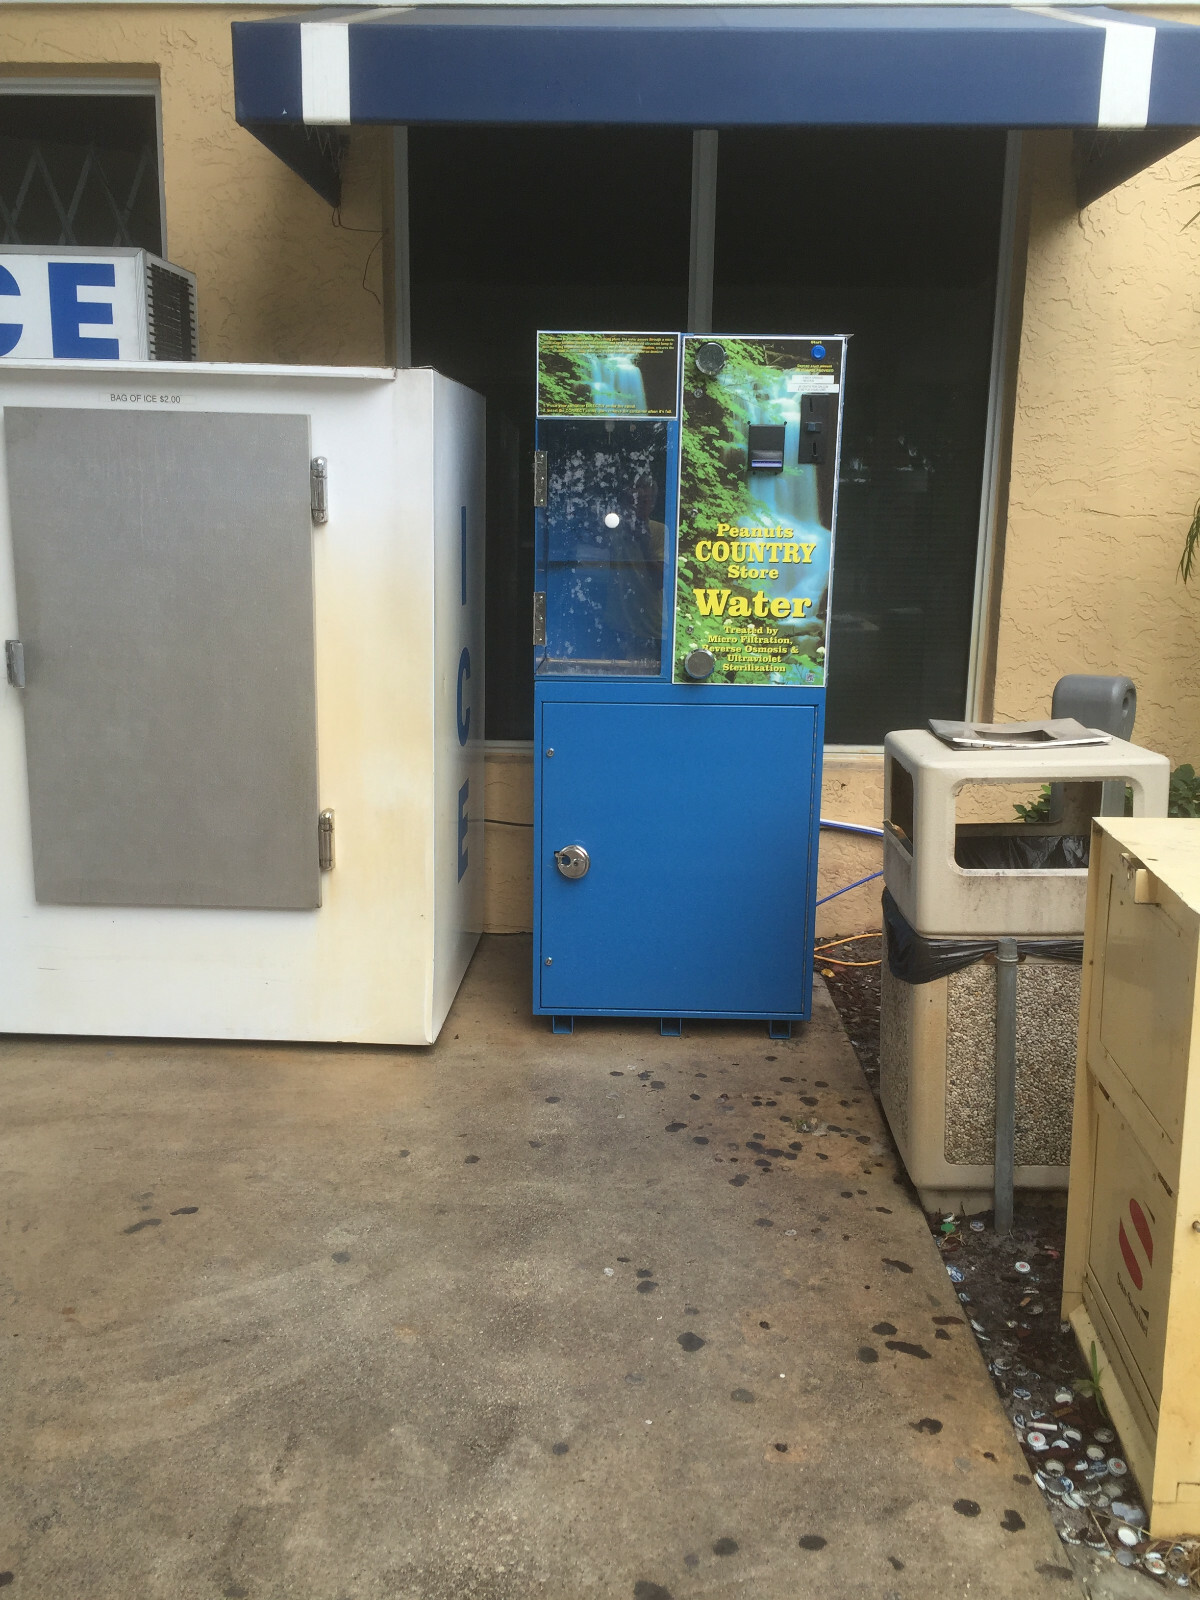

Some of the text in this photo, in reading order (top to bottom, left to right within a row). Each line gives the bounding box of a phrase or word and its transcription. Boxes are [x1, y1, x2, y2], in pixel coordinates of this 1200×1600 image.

[110, 393, 181, 404] BAG OF ICE $2.00
[716, 523, 794, 538] Peanuts
[695, 540, 816, 563] COUNTRY
[727, 564, 779, 579] Store
[693, 588, 812, 618] Water
[724, 626, 779, 636] Treated by
[708, 635, 793, 645] Micro Filtration,
[745, 645, 788, 654] Osmosis
[790, 646, 799, 654] &
[727, 654, 782, 663] Ultraviolet
[722, 663, 786, 672] Sterilization
